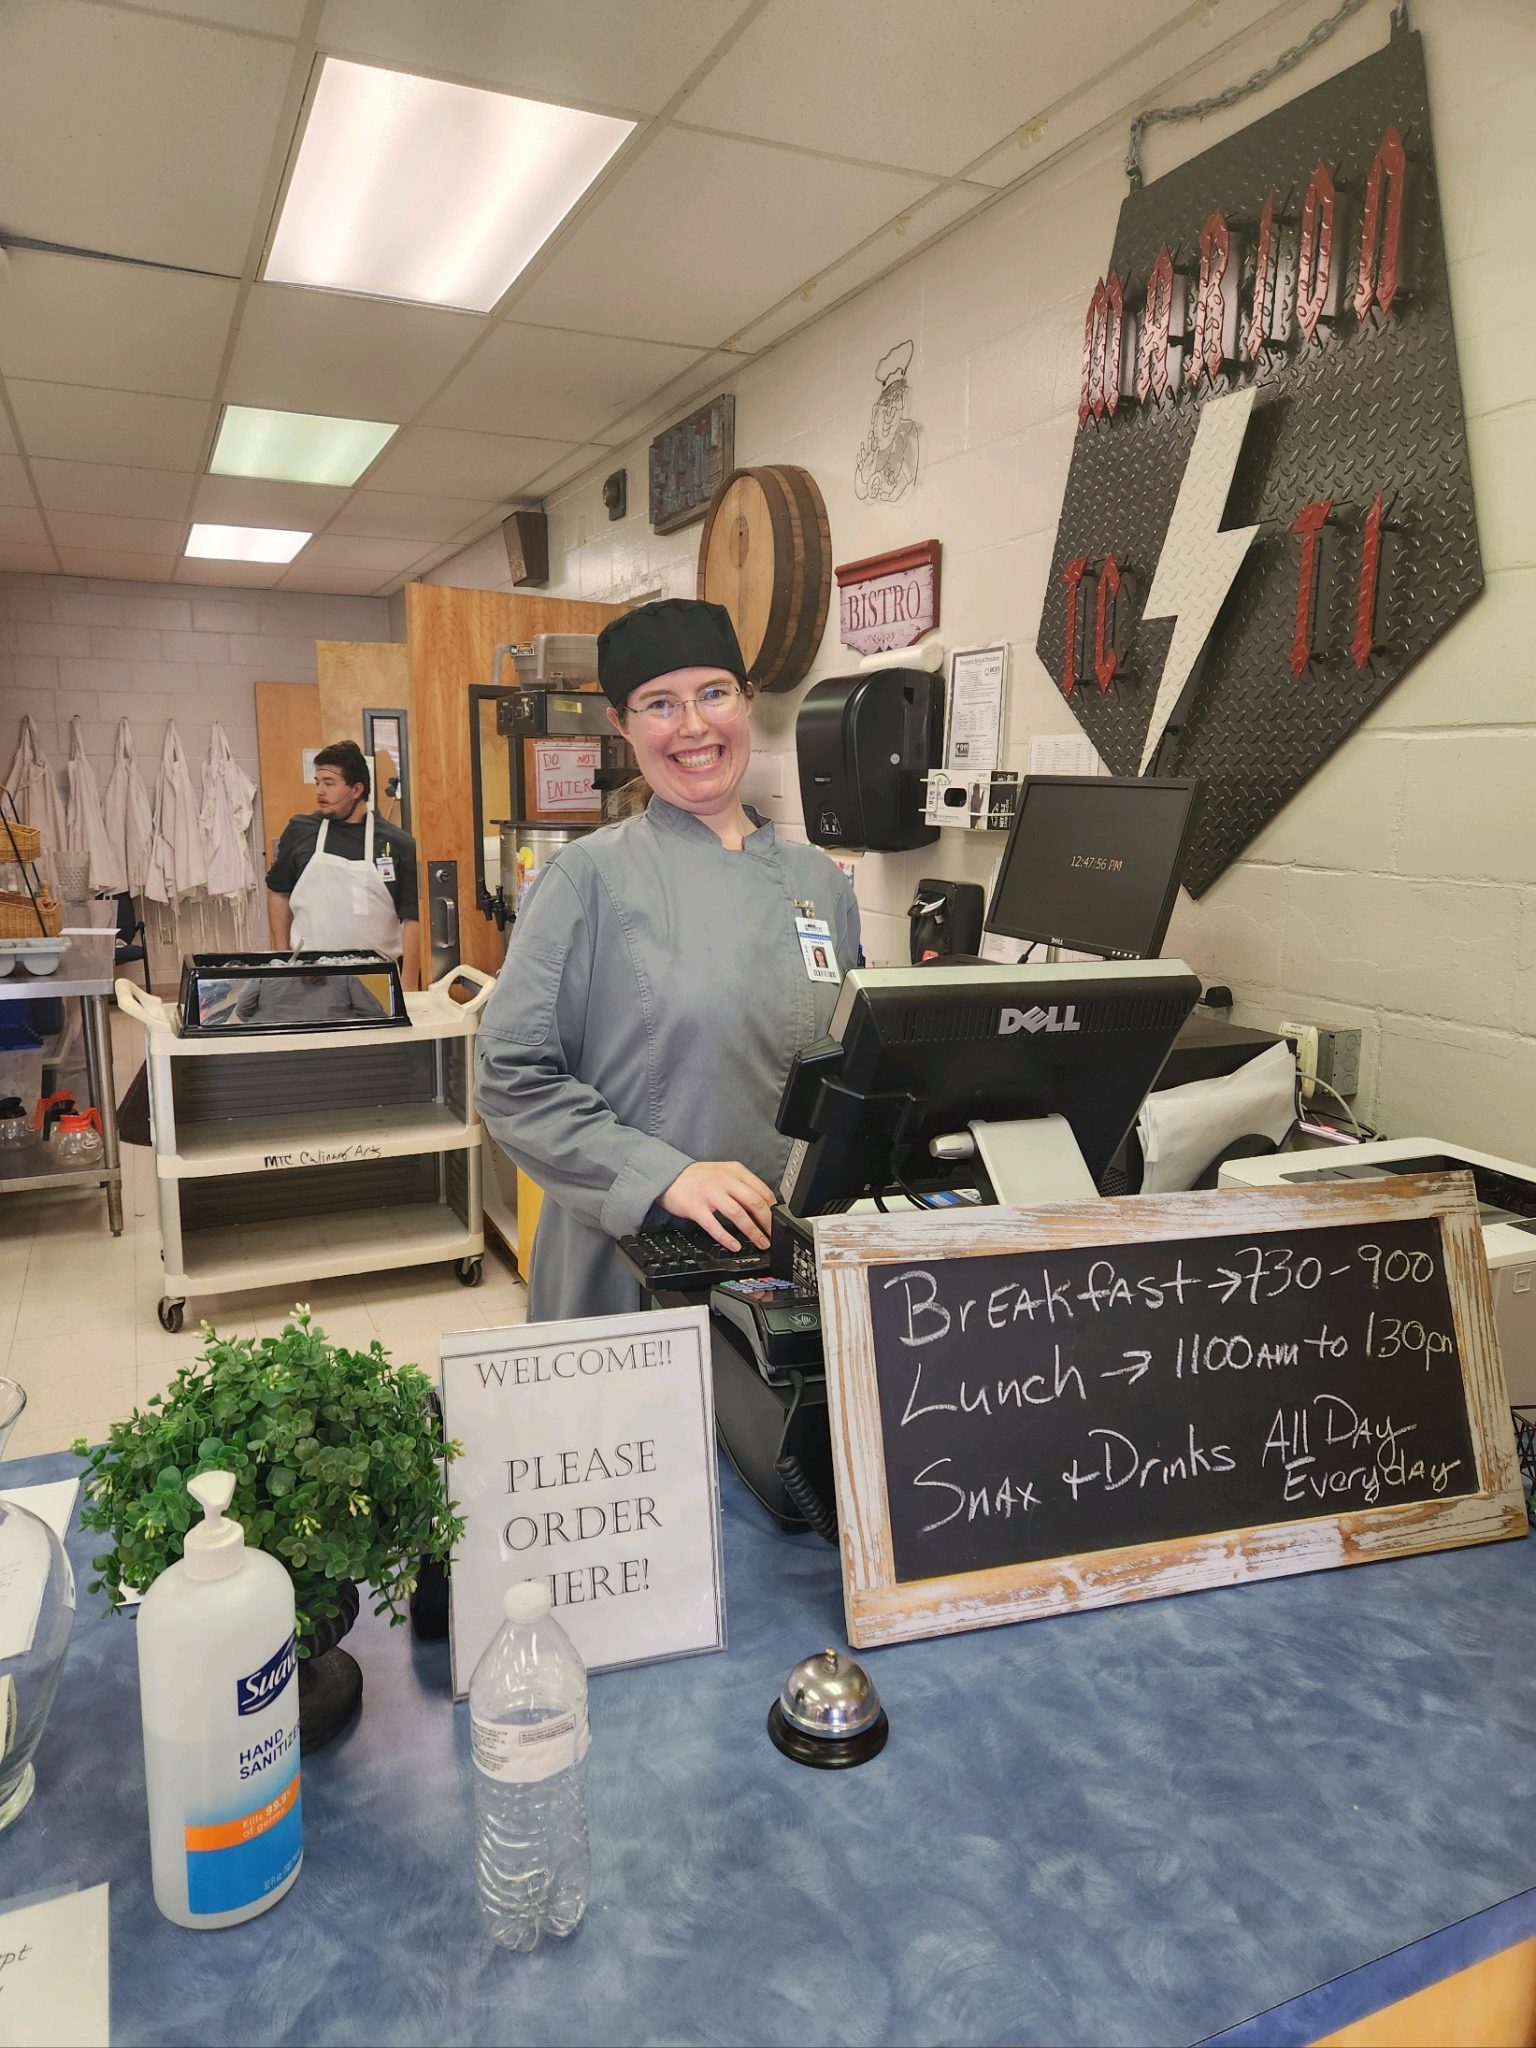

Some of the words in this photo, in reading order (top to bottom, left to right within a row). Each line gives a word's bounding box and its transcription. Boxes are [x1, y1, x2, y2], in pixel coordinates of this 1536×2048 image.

[848, 580, 921, 632] BISTRO
[543, 753, 559, 768] DO
[577, 754, 597, 765] NOT
[546, 779, 594, 800] ENTER
[1071, 855, 1107, 871] 12:47:56
[1108, 859, 1123, 872] PM
[998, 1005, 1080, 1034] DELL
[264, 1153, 293, 1168] MTC
[300, 1146, 353, 1165] Culinary
[355, 1145, 382, 1158] Arts
[475, 1340, 672, 1389] WELCOME!!
[902, 1345, 1086, 1427] Lunch
[1305, 1326, 1347, 1359] to
[504, 1440, 657, 1495] PLEASE
[1089, 1425, 1236, 1490] Drinks
[1261, 1408, 1309, 1468] All
[503, 1497, 663, 1551] ORDER
[240, 1729, 283, 1765] HAND
[240, 1719, 300, 1781] SANITIZE
[243, 1813, 264, 1830] Kills
